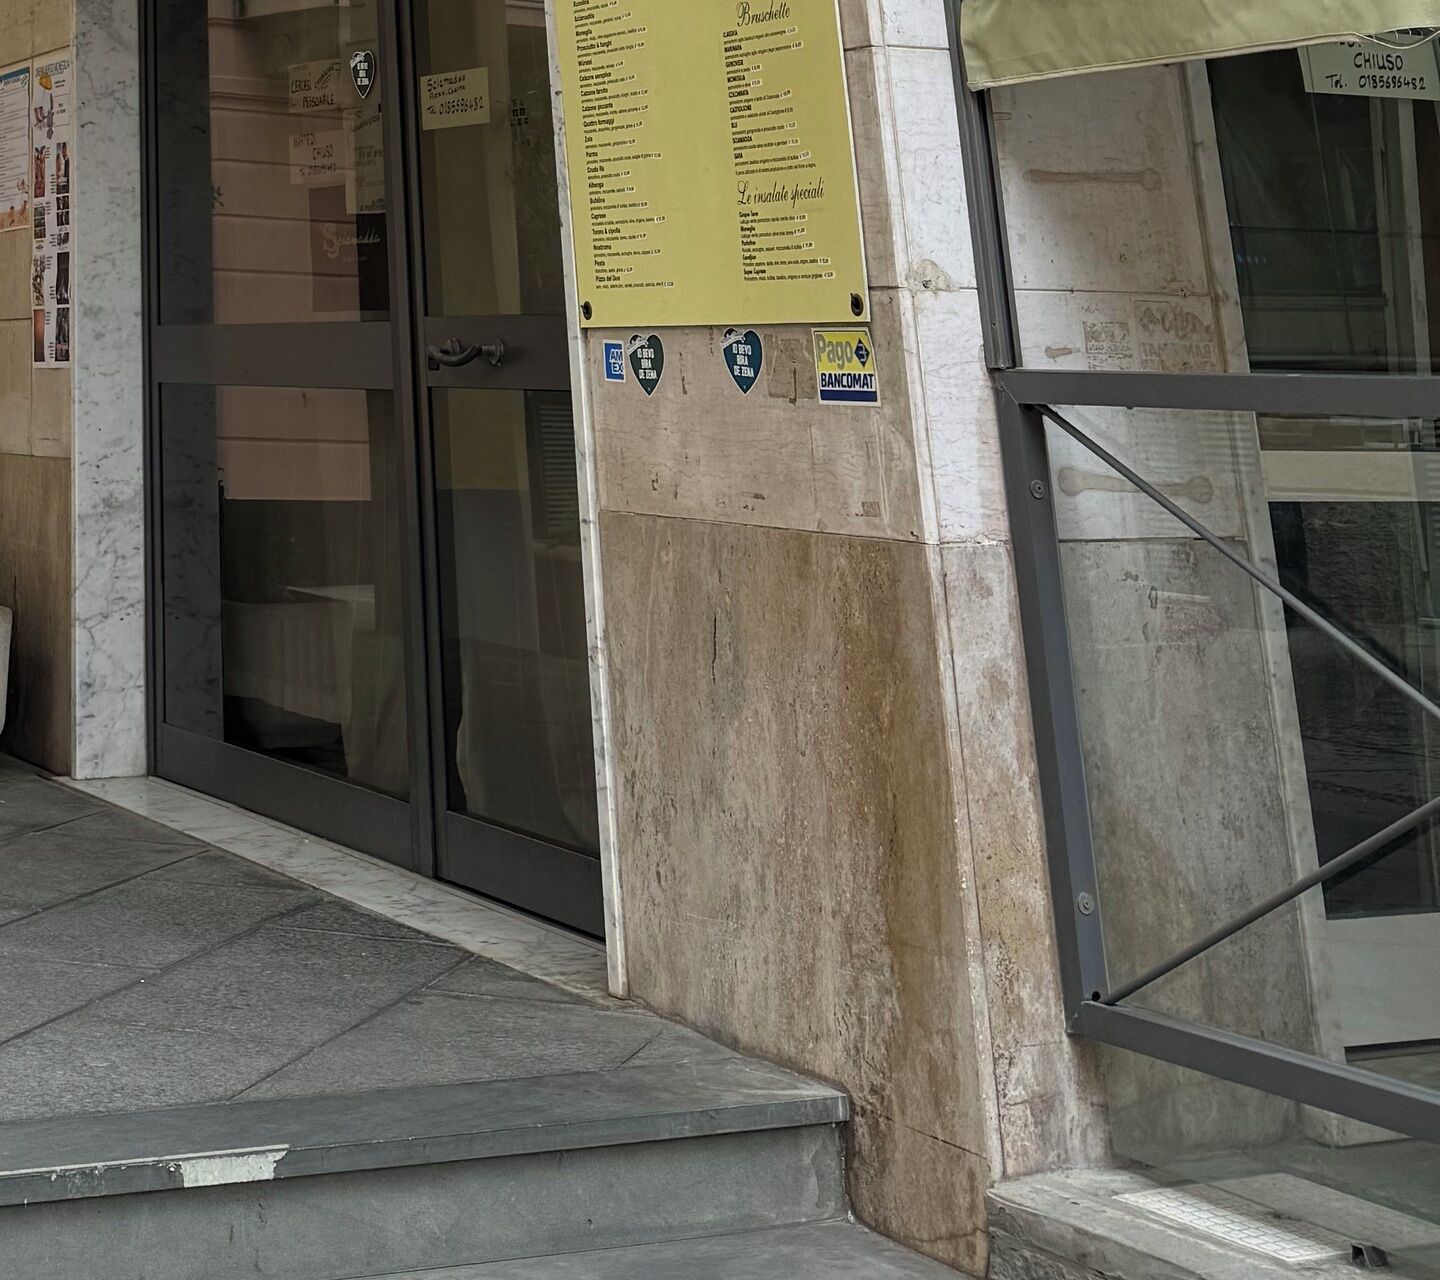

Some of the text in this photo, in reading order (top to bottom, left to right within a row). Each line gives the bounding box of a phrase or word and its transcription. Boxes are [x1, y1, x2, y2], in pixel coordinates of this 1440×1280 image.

[736, 0, 791, 28] Bruschette
[1353, 52, 1404, 71] CHIUSO
[737, 176, 824, 209] Le insalate speciali
[815, 333, 853, 370] Pago
[821, 372, 874, 389] BANCOMAT
